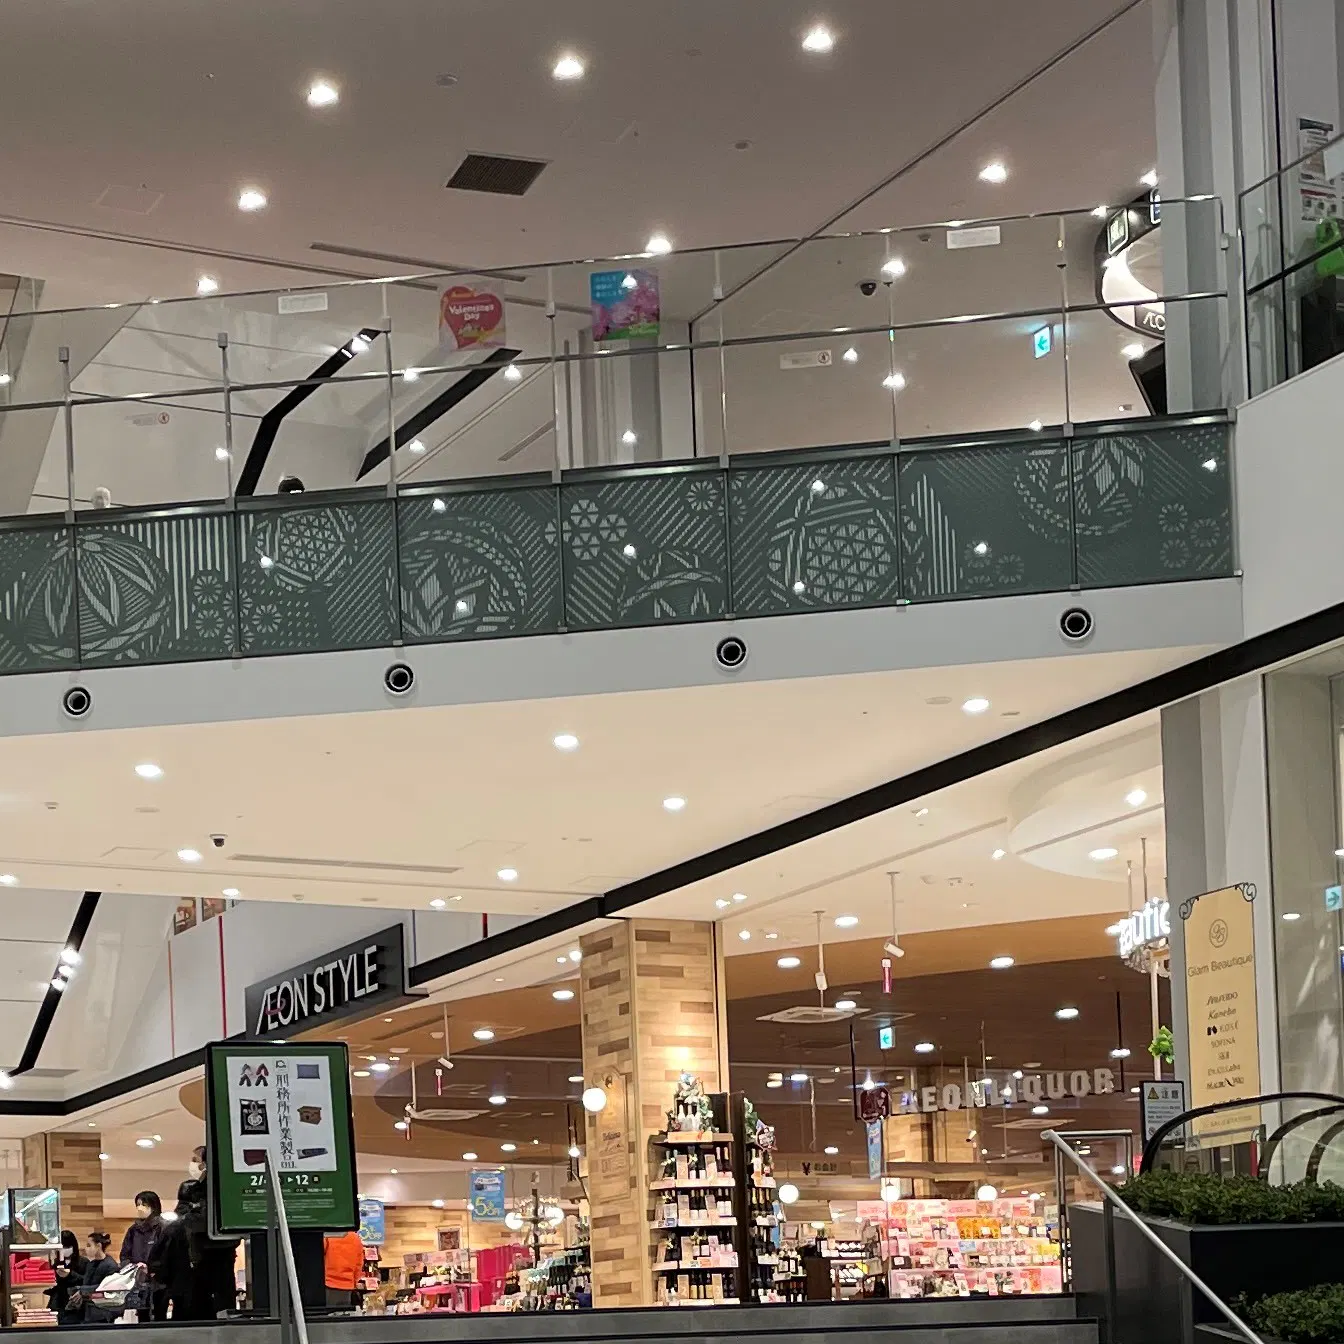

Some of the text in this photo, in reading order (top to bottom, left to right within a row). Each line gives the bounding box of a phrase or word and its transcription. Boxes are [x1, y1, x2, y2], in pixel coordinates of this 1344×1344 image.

[313, 944, 379, 1014] STYLE
[989, 1067, 1116, 1106] LIQUOR
[295, 1174, 309, 1186] 12
